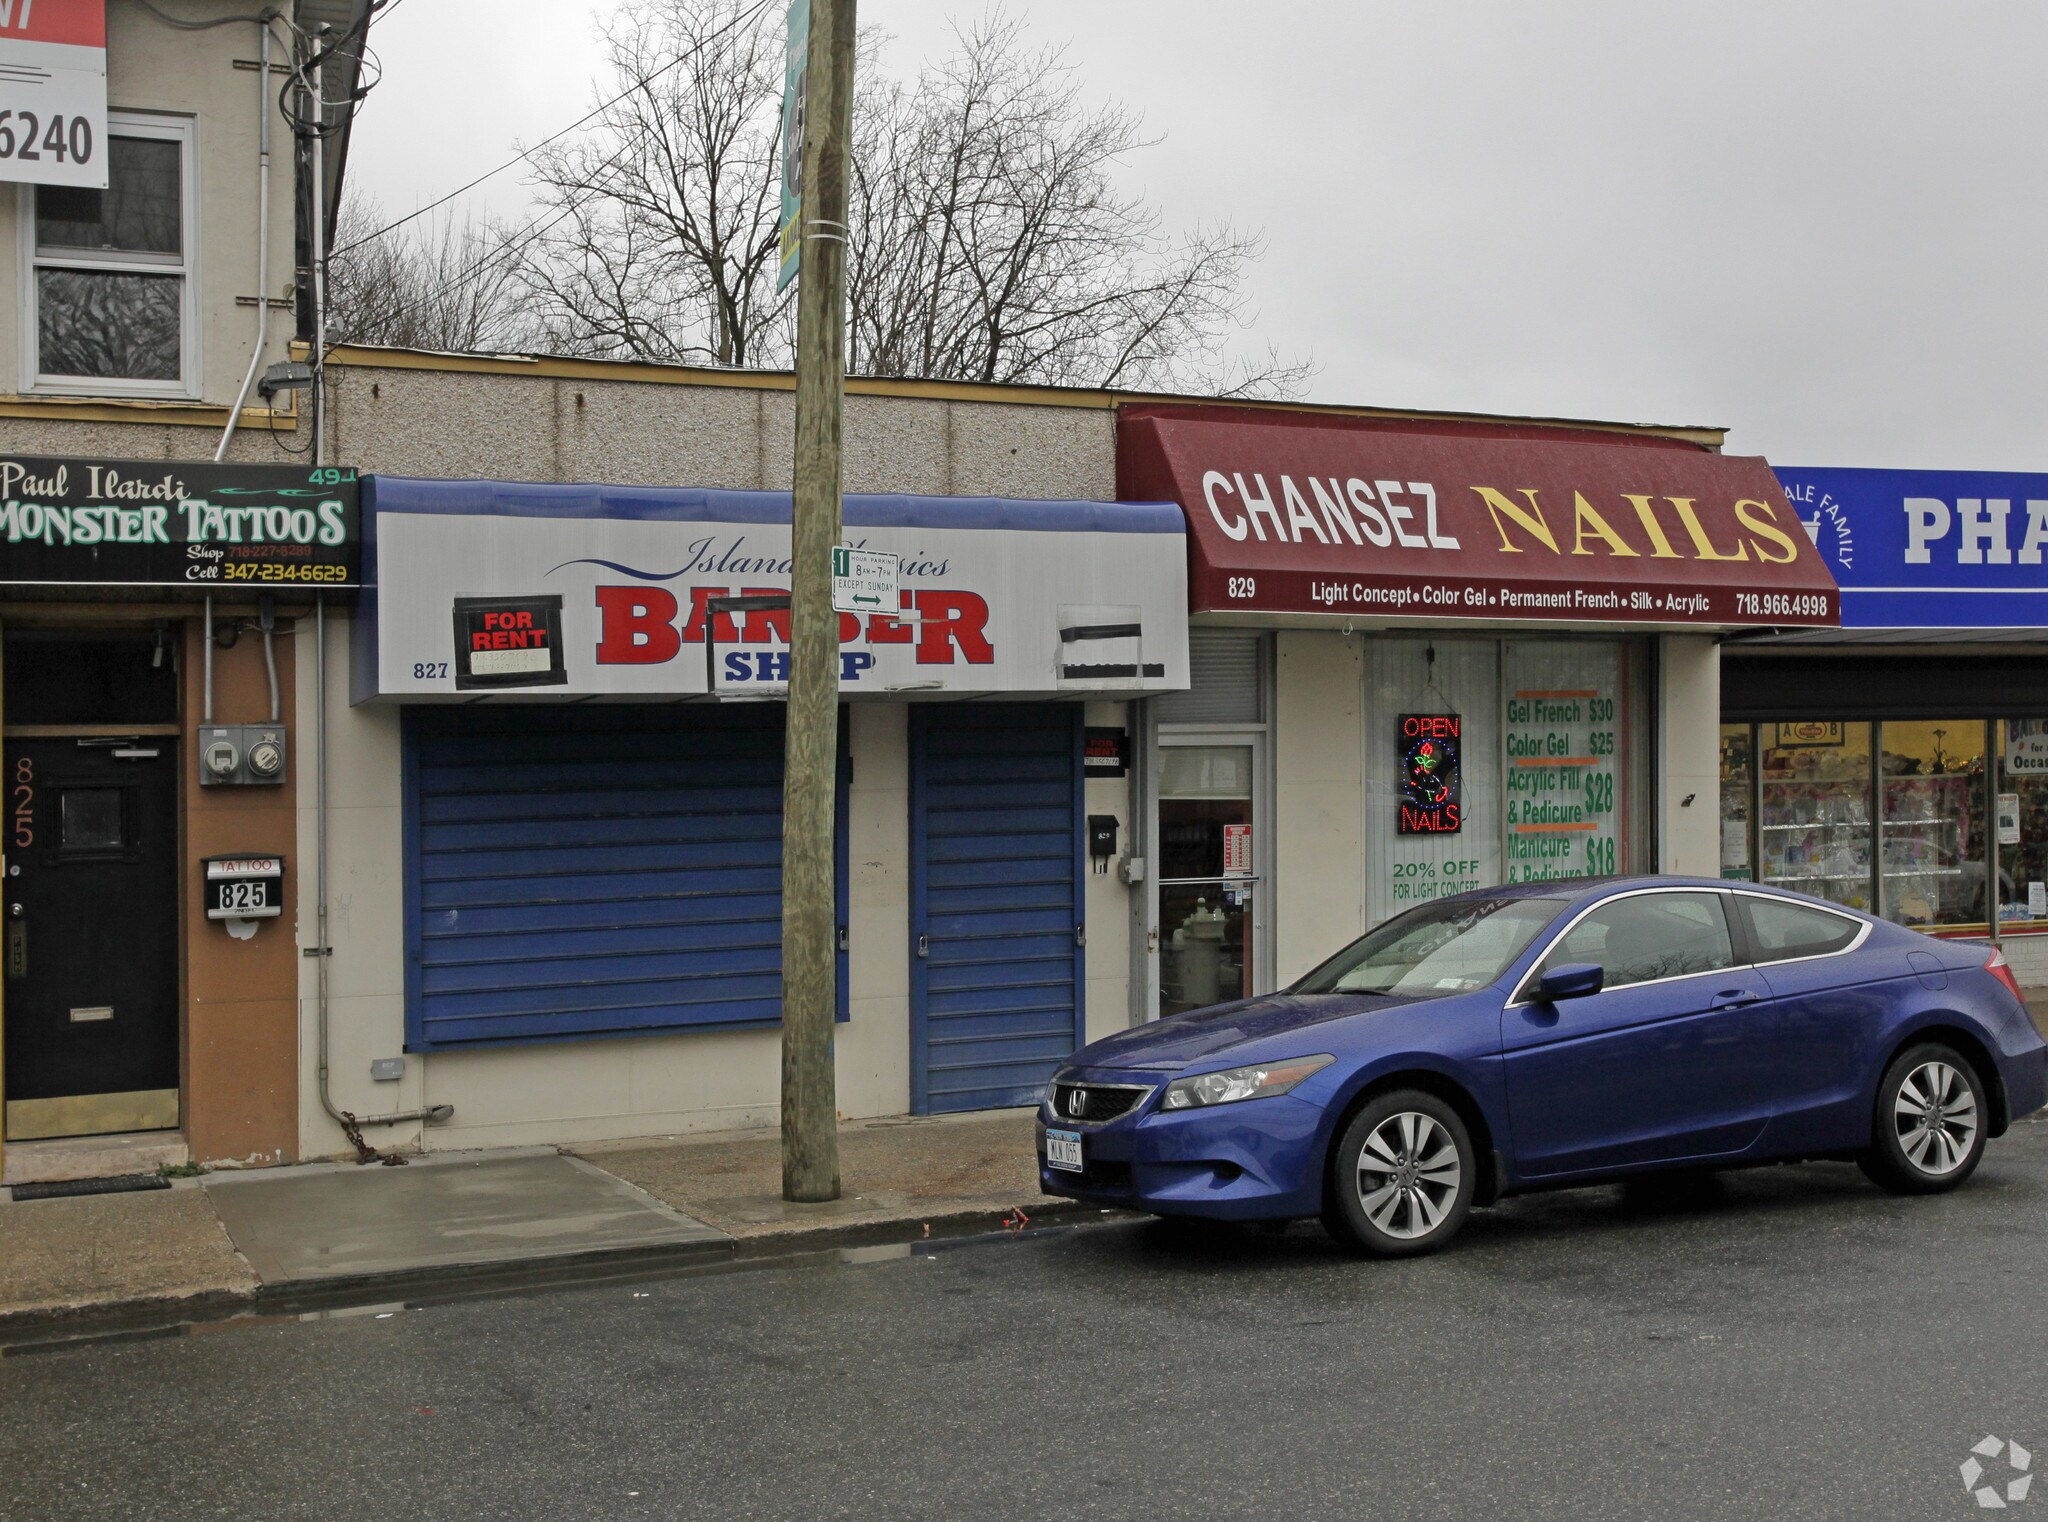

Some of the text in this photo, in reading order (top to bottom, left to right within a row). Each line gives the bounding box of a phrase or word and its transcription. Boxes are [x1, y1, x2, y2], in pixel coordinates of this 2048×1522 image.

[0, 110, 92, 165] 6240
[0, 462, 191, 501] Paul Ilardi
[0, 499, 346, 546] MONSTER TATTOOS
[1202, 470, 1799, 563] CHANSEZ NAILS
[1820, 494, 1853, 569] FAMILY
[186, 543, 313, 562] Shop 718-227-8289
[870, 557, 895, 565] PARKING
[185, 563, 347, 581] Cell 347-234-6629
[838, 579, 894, 592] EXCEPT SUNDAY
[1228, 577, 1256, 598] 829
[1312, 582, 1349, 605] Light
[1501, 588, 1571, 607] Permanent
[1575, 590, 1618, 608] French
[1631, 592, 1652, 610] Silk
[1666, 593, 1709, 615] Acrylic
[1736, 593, 1827, 616] 718.966.4998
[484, 612, 533, 630] FOR
[472, 630, 547, 650] RENT
[413, 662, 448, 679] 827
[725, 651, 877, 682] SHP
[1507, 699, 1613, 723] Gel French $30
[1404, 717, 1459, 737] OPEN
[1507, 732, 1613, 757] Color Gel $25
[2031, 742, 2043, 752] for
[1507, 767, 1580, 797] Acrylic Fill
[1585, 770, 1613, 818] $28
[14, 757, 33, 847] 825
[1507, 800, 1582, 824] & Pedicure
[1402, 804, 1459, 832] NAILS
[1508, 833, 1571, 859] Manicure
[1587, 835, 1615, 876] $18
[219, 860, 272, 872] TATTOO
[1393, 860, 1479, 878] 20% OFF
[222, 884, 264, 908] 825
[1393, 883, 1410, 899] FOR
[1413, 882, 1438, 898] LIGHT
